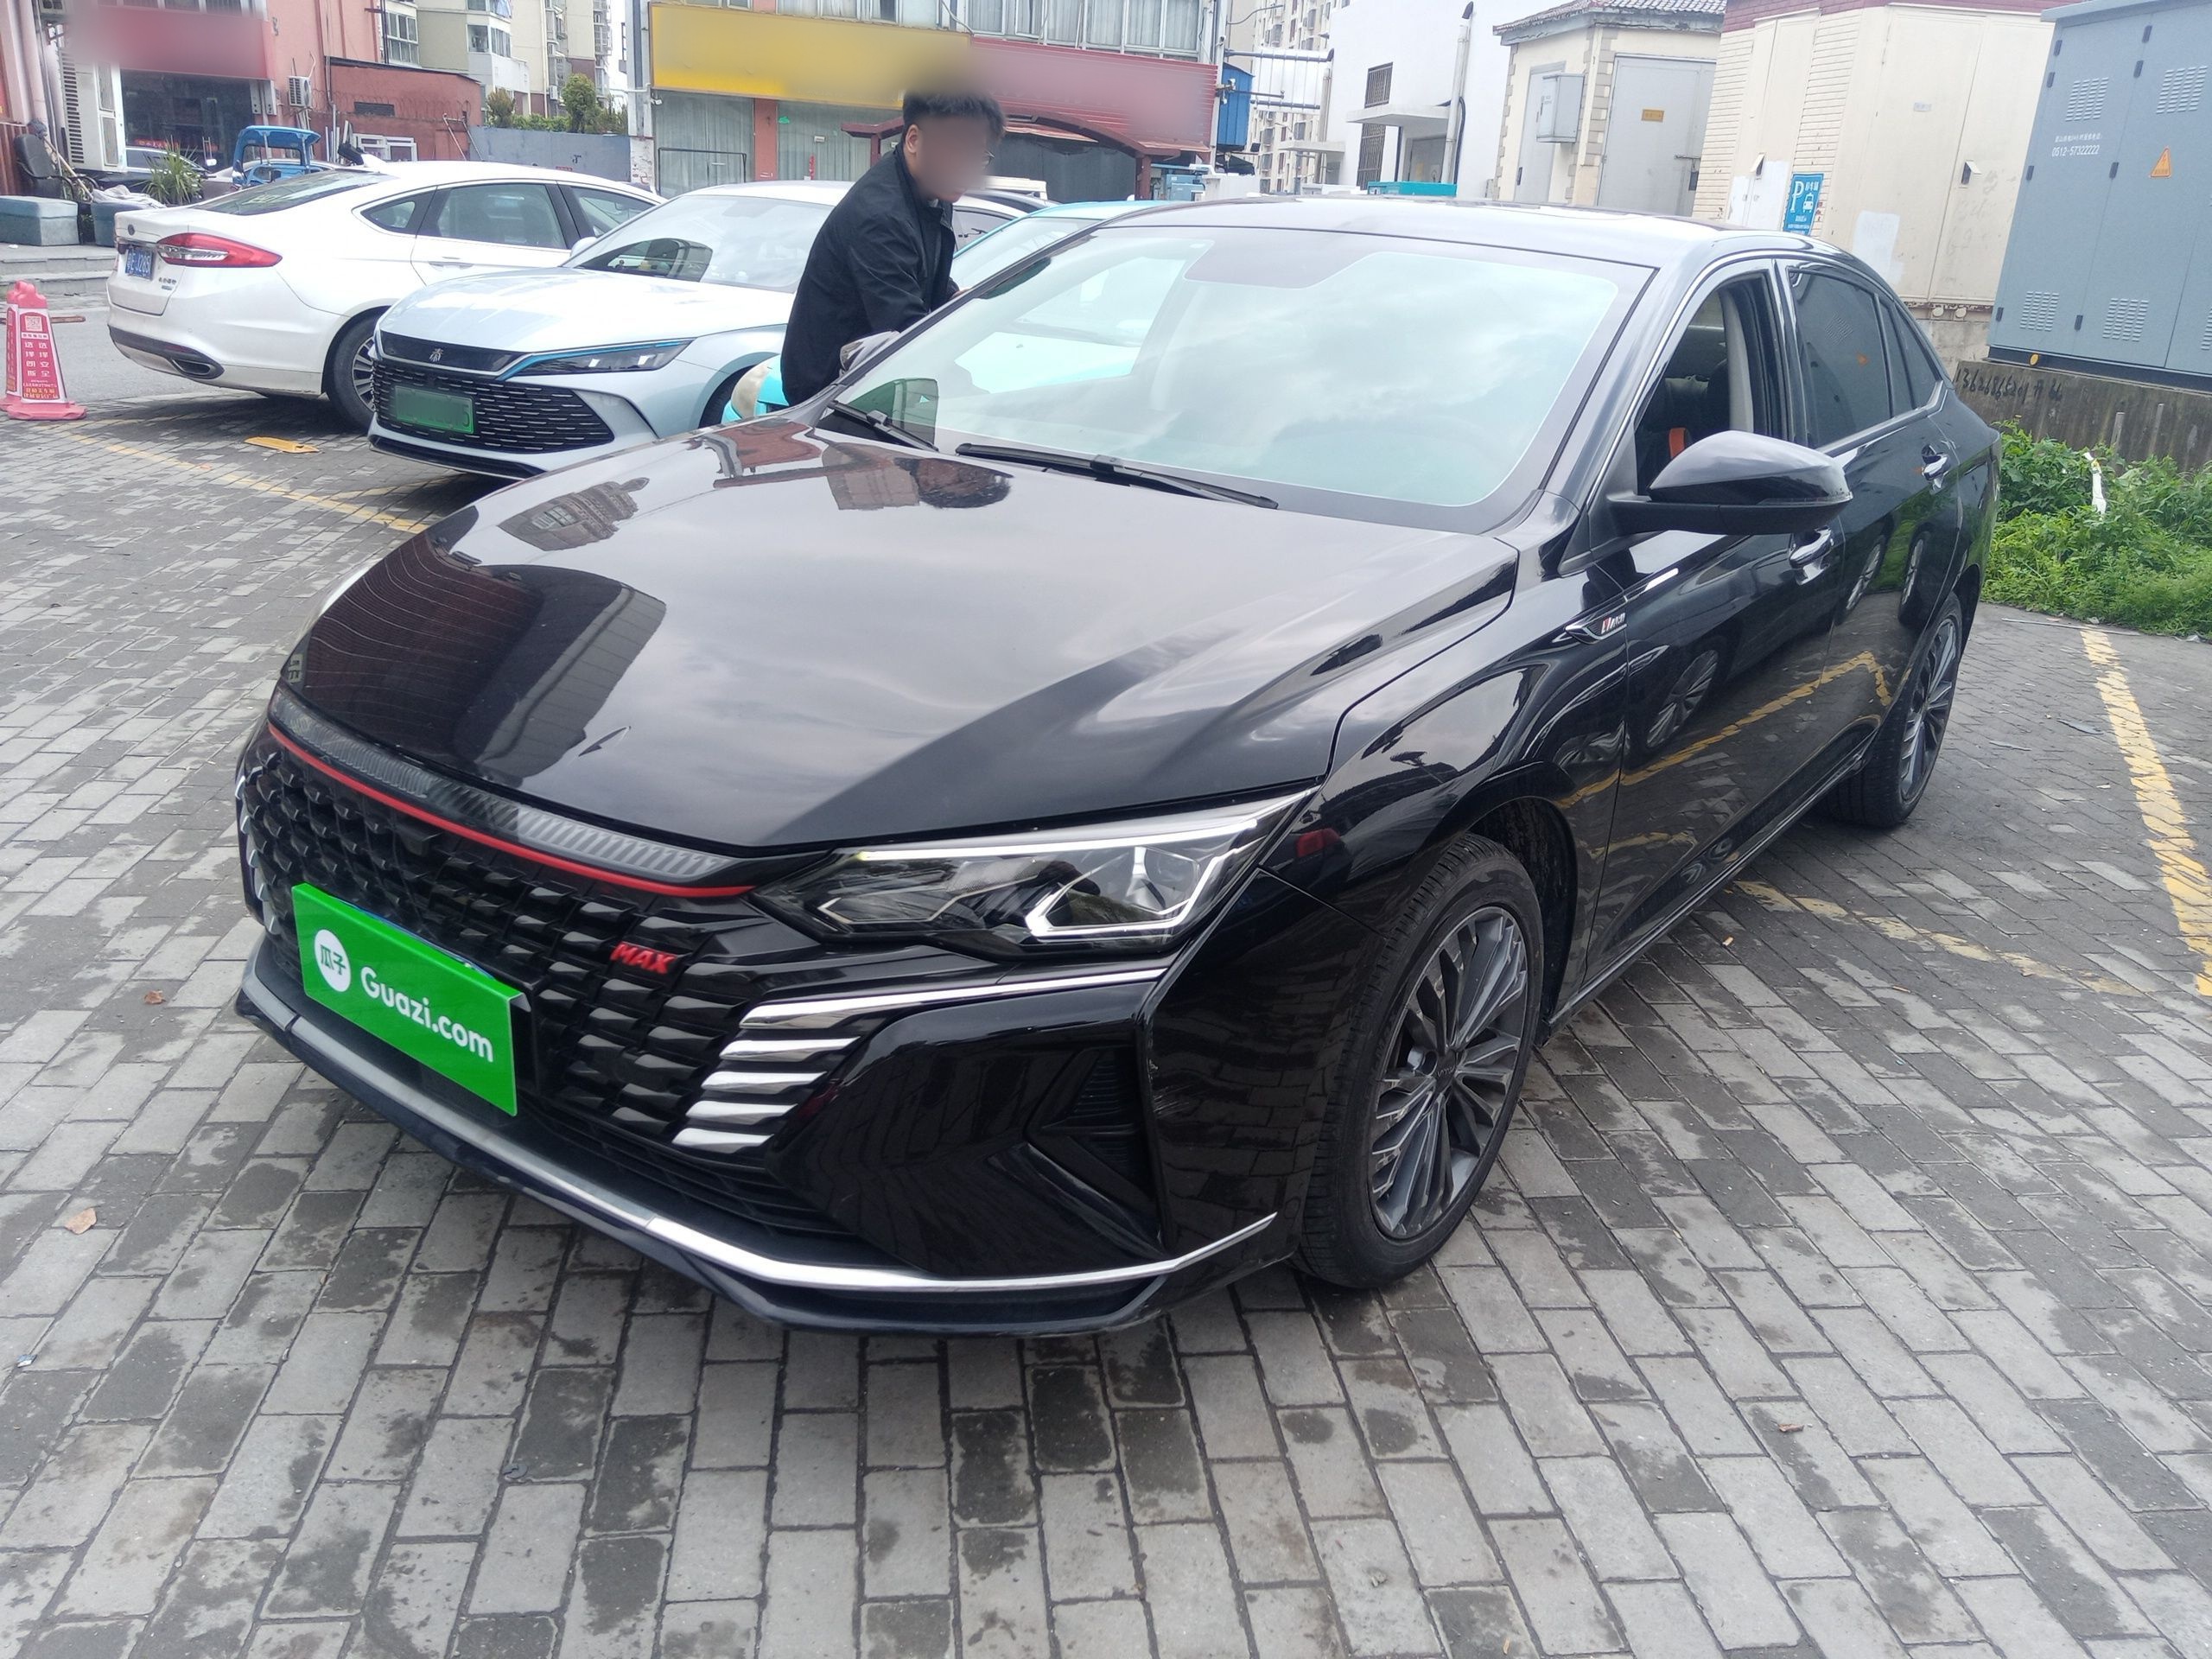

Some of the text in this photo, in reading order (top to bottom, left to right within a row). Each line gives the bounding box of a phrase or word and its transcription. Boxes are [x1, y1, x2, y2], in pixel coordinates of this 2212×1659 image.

[2051, 144, 2101, 157] 0512-57322222
[1790, 180, 1805, 213] P
[320, 944, 346, 976] 瓜子
[610, 943, 677, 974] MAX
[360, 965, 494, 1063] Guazi.com
